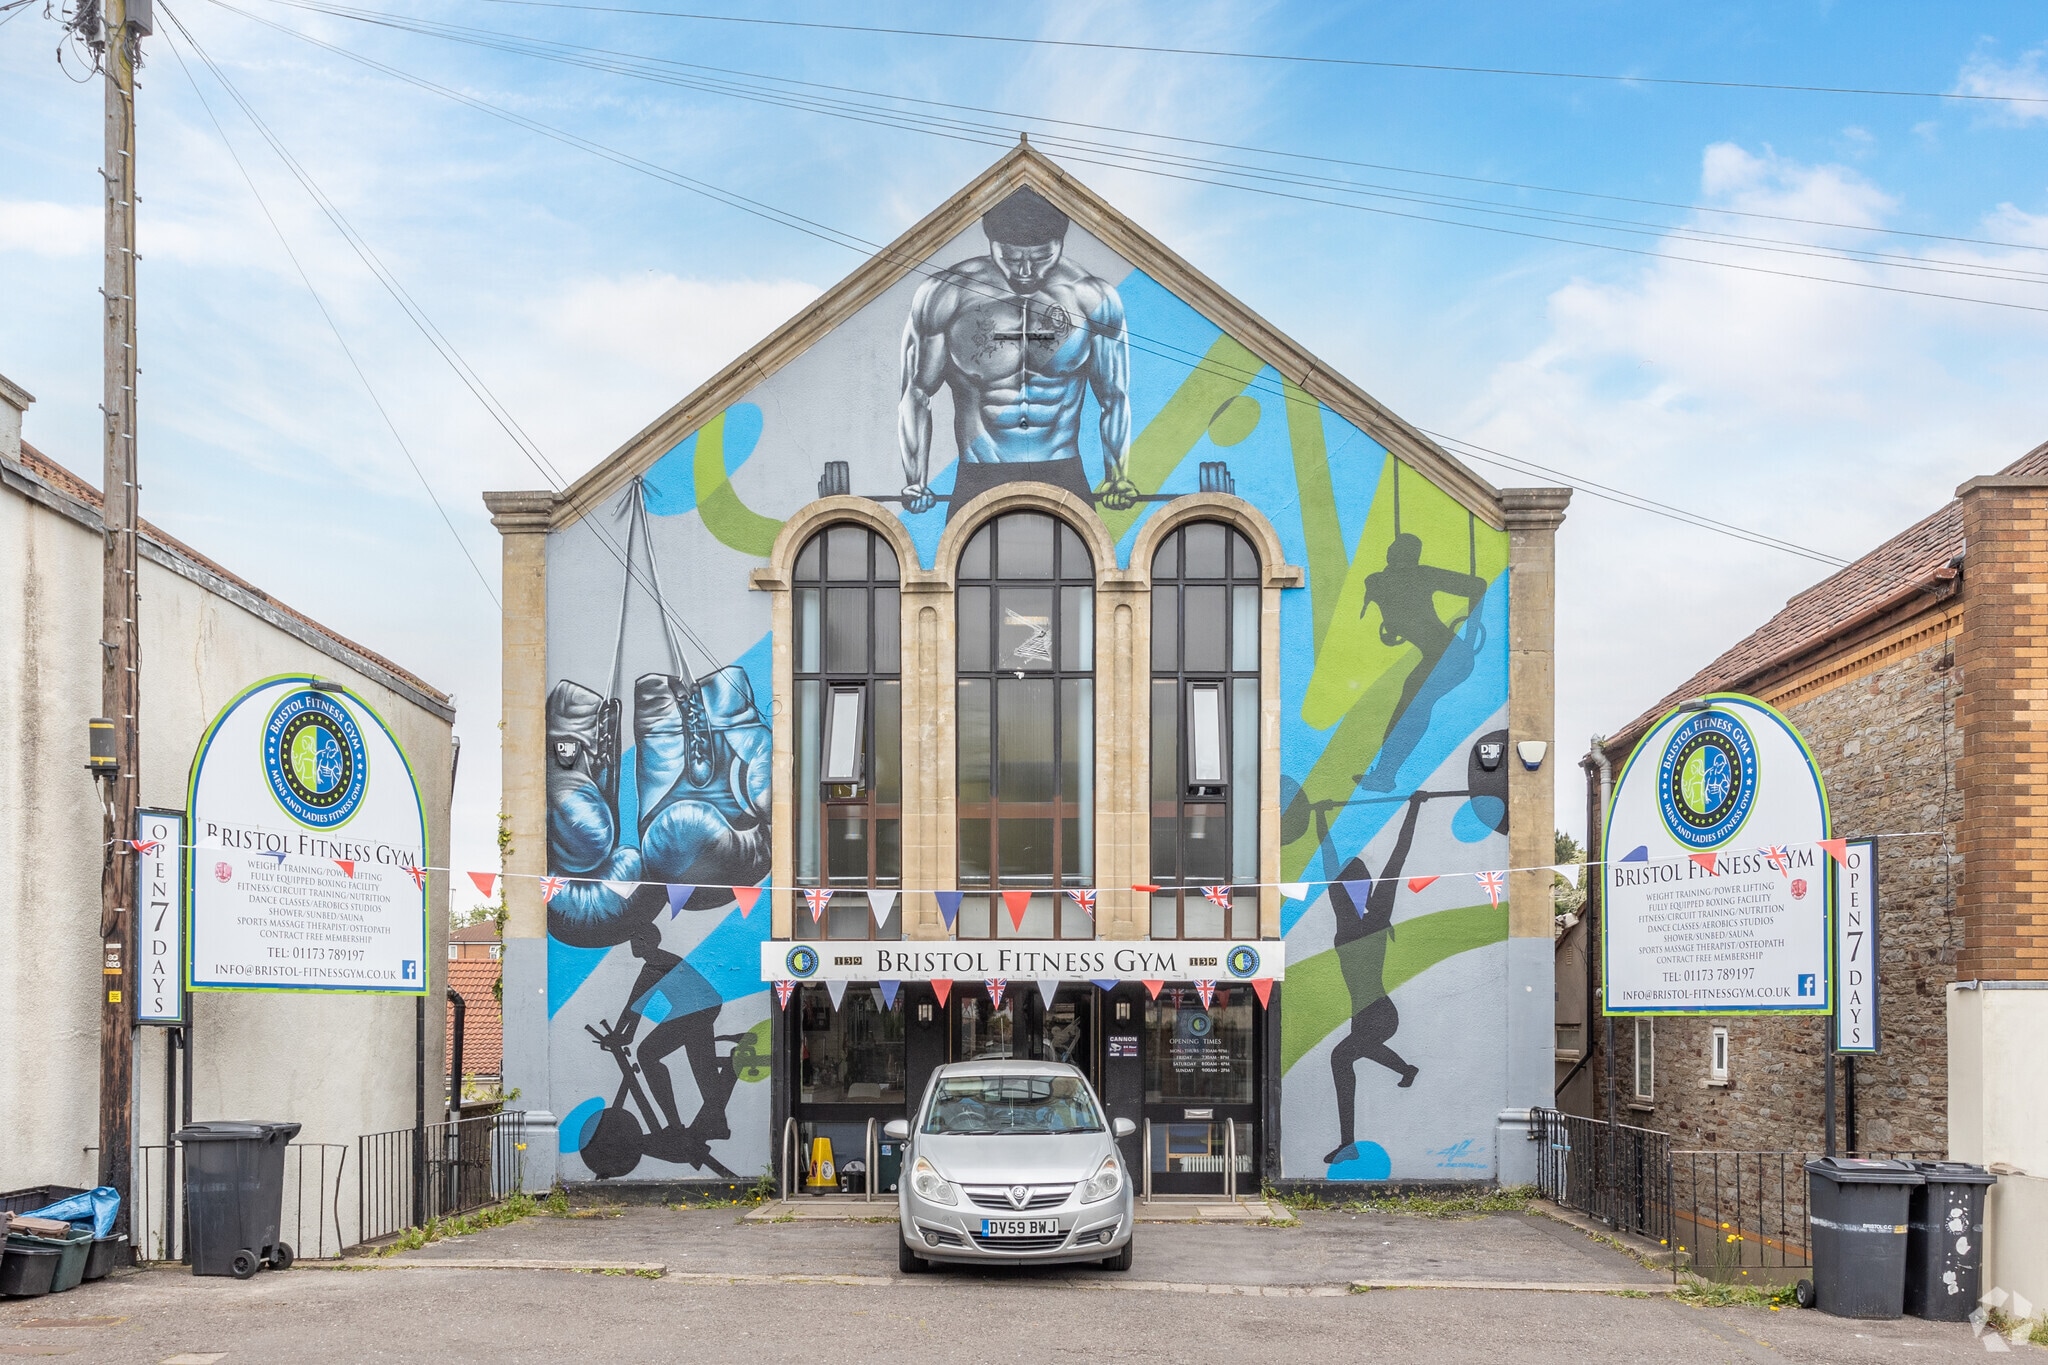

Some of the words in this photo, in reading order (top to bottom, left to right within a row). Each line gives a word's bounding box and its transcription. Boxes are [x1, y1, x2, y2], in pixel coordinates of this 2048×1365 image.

[270, 700, 304, 734] BRISTOL
[305, 696, 344, 722] FITNESS
[344, 722, 360, 750] GYM
[1663, 728, 1692, 769] BRISTOL
[1694, 718, 1733, 732] FITNESS
[1732, 728, 1750, 755] GYM
[272, 770, 288, 797] MENS
[284, 796, 302, 814] AND
[302, 810, 328, 822] LADIES
[328, 798, 354, 822] FITNESS
[351, 783, 362, 800] GYM
[1664, 803, 1678, 827] MENS
[1676, 824, 1692, 840] AND
[1692, 832, 1716, 843] LADIES
[1717, 810, 1743, 838] FITNESS
[1740, 790, 1751, 809] GYM
[299, 834, 371, 862] FITNESS
[376, 844, 415, 867] GYM
[248, 860, 282, 871] WEIGHT
[283, 863, 353, 878] TRAINING/POWE
[354, 872, 382, 882] LIFTING
[1615, 864, 1683, 888] BRISTOL
[1688, 854, 1761, 879] FINESS
[250, 872, 276, 882] FULLY
[276, 874, 316, 885] EQUIPPED
[317, 878, 347, 888] BOXING
[348, 880, 380, 892] FACILITY
[1646, 892, 1674, 902] WEIGHT
[1676, 885, 1742, 898] TRAINING/POWER
[1743, 882, 1775, 892] LIFTING
[1848, 853, 1861, 927] OPEN
[238, 882, 307, 896] FITNESS/CIRCUIT
[308, 888, 391, 903] TRAINING/NUTRITION
[248, 894, 277, 904] DANCE
[279, 898, 349, 910] CLASSES/AEROBICS
[350, 904, 382, 913] STUDIOS
[1648, 903, 1668, 912] FULLY
[1670, 900, 1704, 910] EQUIPPED
[1706, 897, 1736, 908] BOXING
[1737, 894, 1772, 904] FACILITY
[150, 902, 170, 932] 7
[269, 907, 364, 922] SHOWER/SUNBED/SAUNA
[1638, 911, 1696, 924] FITNESS/CIRCUIT
[1698, 904, 1785, 918] TRAINING/NUTRITION
[237, 916, 268, 927] SPORTS
[270, 919, 304, 929] MASSAGE
[307, 922, 391, 934] THERAPIST/OSTEOPATH
[1648, 924, 1670, 934] DANCE
[1672, 919, 1738, 932] CLASSES/AEROBICS
[1739, 916, 1774, 926] STUDIOS
[260, 930, 304, 940] CONTRACT
[306, 932, 324, 942] FREE
[325, 934, 372, 944] MEMBERSHIP
[1638, 946, 1662, 954] SPORTS
[1664, 944, 1694, 953] MASSAGE
[1696, 938, 1785, 952] THERAPIST/OSTEOPATH
[1664, 930, 1754, 942] SHOWER/SUNBED/SAUNA
[267, 947, 290, 958] TEL:
[292, 947, 325, 960] 01173
[328, 948, 364, 962] 789197
[1847, 931, 1864, 962] 7
[834, 956, 862, 966] 139
[877, 950, 988, 972] BRISTOL
[998, 950, 1104, 972] FITNESS
[1114, 949, 1177, 972] GYM
[1190, 958, 1217, 966] 139
[1656, 955, 1694, 964] CONTRACT
[1696, 954, 1712, 962] FREE
[1714, 952, 1764, 962] MEMBERSHIP
[152, 940, 167, 1013] DAYS
[215, 964, 397, 980] INFO@BRISTOL-FITNESSGYM.CO.UK
[1662, 971, 1682, 982] TEL:
[1684, 968, 1714, 982] 01173
[1718, 968, 1754, 980] 789197
[1622, 986, 1790, 1000] INFO@BRISTOL-FITNESSGYM.CO.UK
[1850, 970, 1862, 1044] DAYS
[990, 1222, 1026, 1234] DV59
[1030, 1221, 1056, 1234] BWJ
